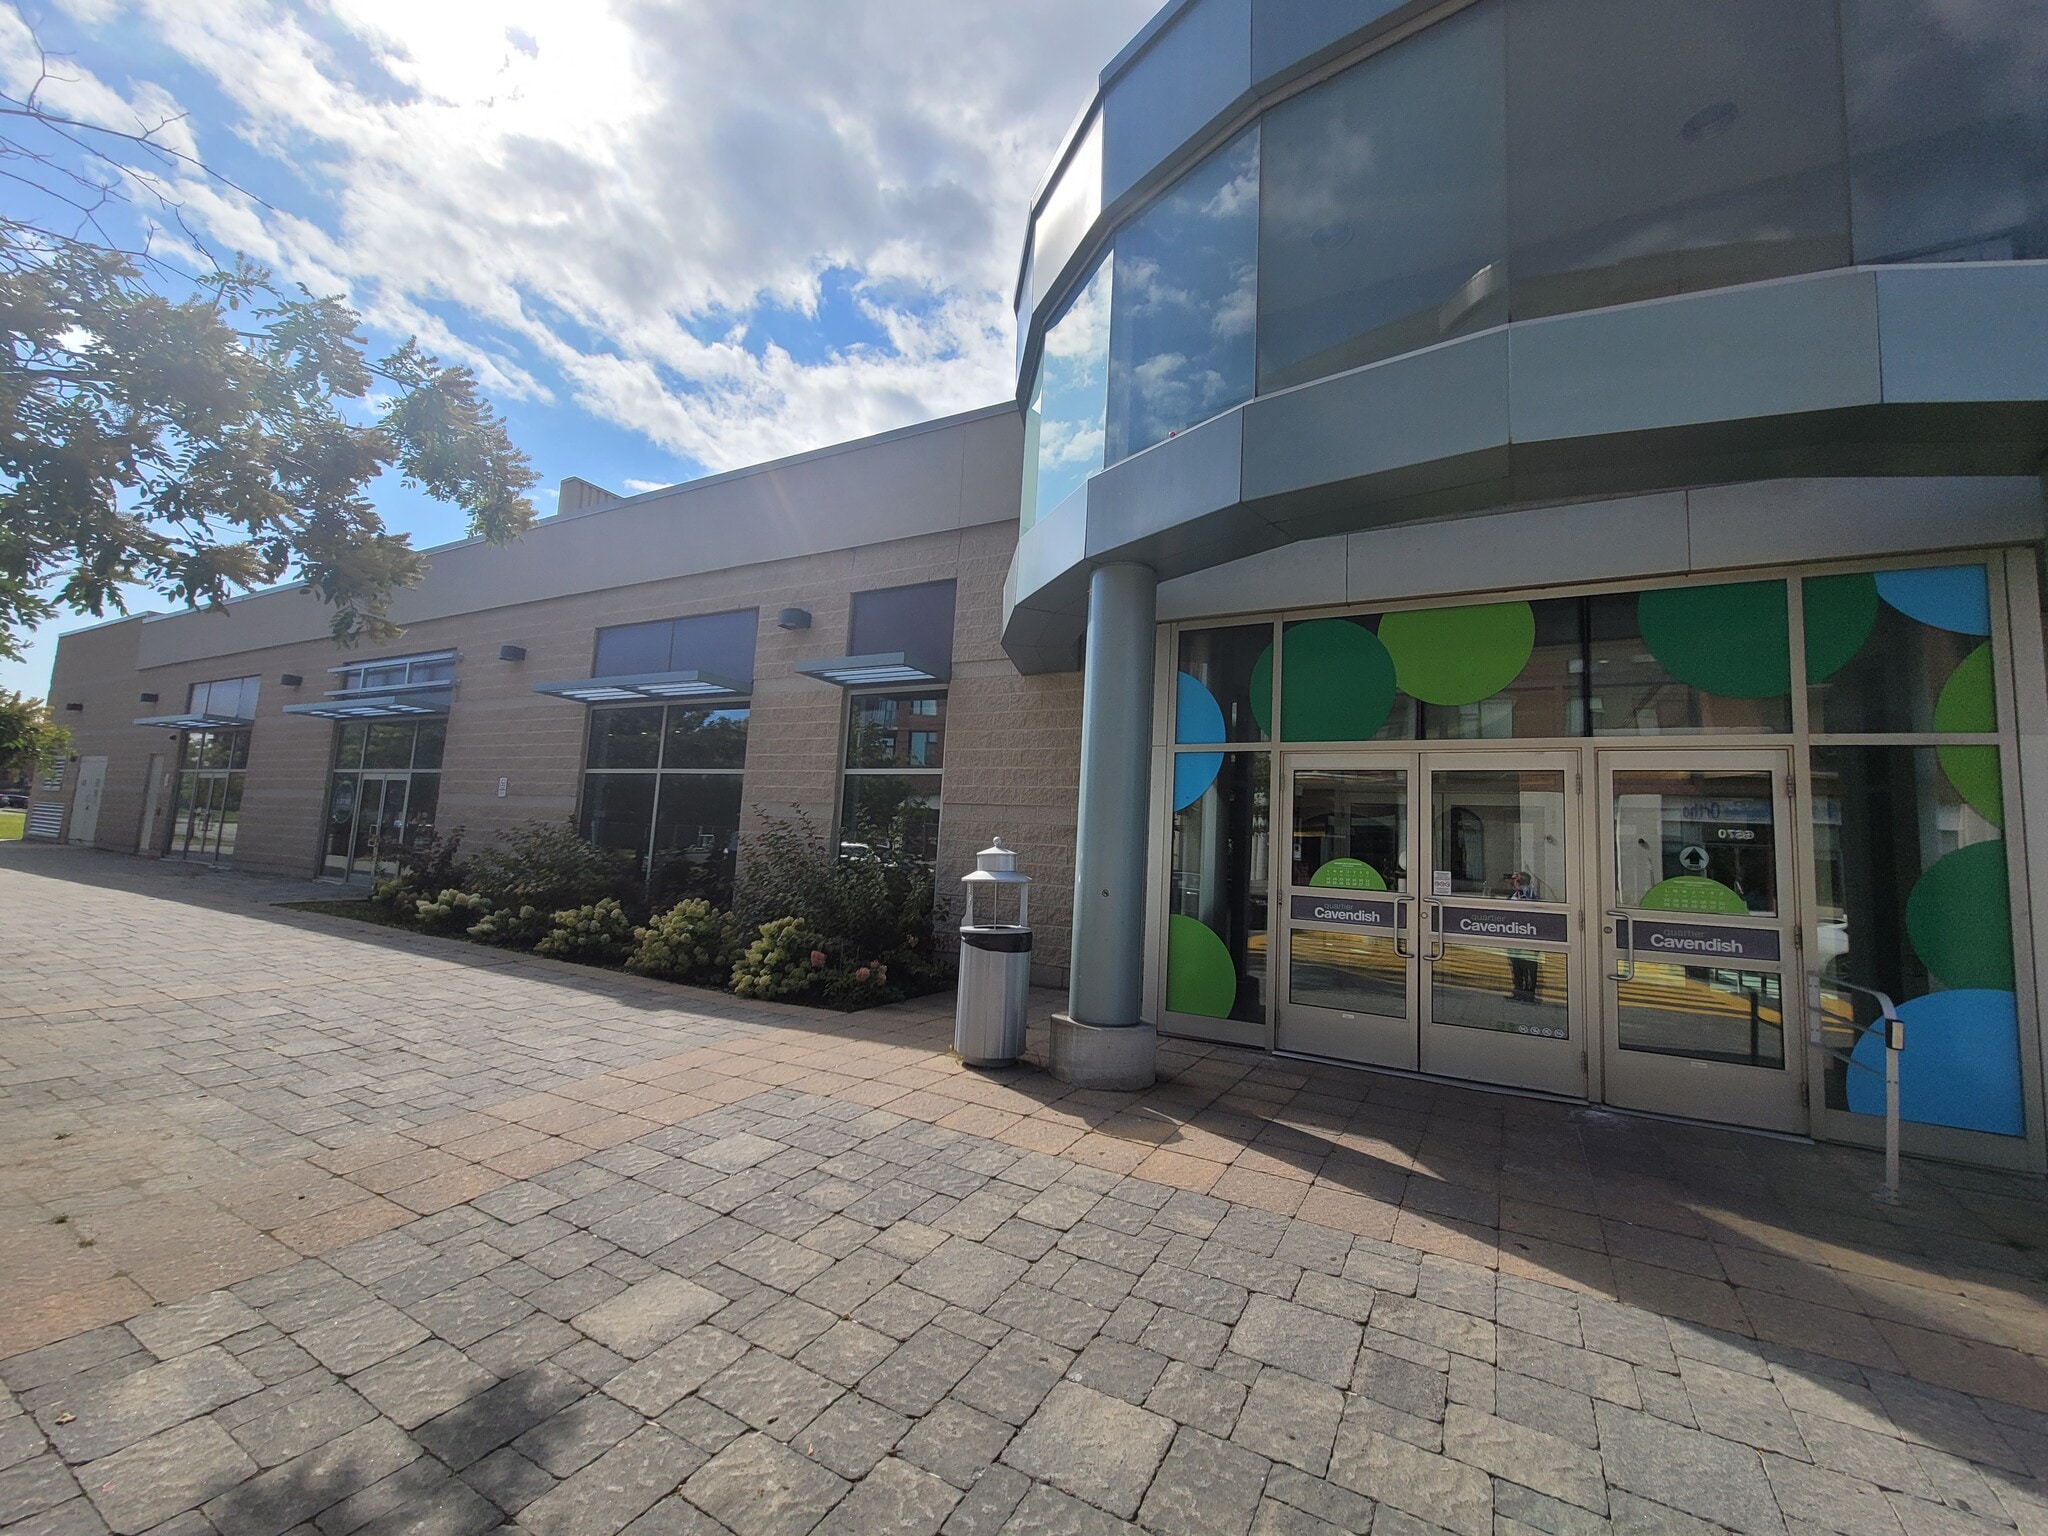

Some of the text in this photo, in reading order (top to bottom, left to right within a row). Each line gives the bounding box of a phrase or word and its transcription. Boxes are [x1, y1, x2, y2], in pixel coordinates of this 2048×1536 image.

[1324, 903, 1354, 911] quartier
[1314, 906, 1381, 923] Cavendish
[1471, 914, 1505, 922] quartier
[1460, 918, 1537, 936] Cavendish
[1663, 928, 1705, 938] quartier
[1650, 933, 1743, 953] Cavendish
